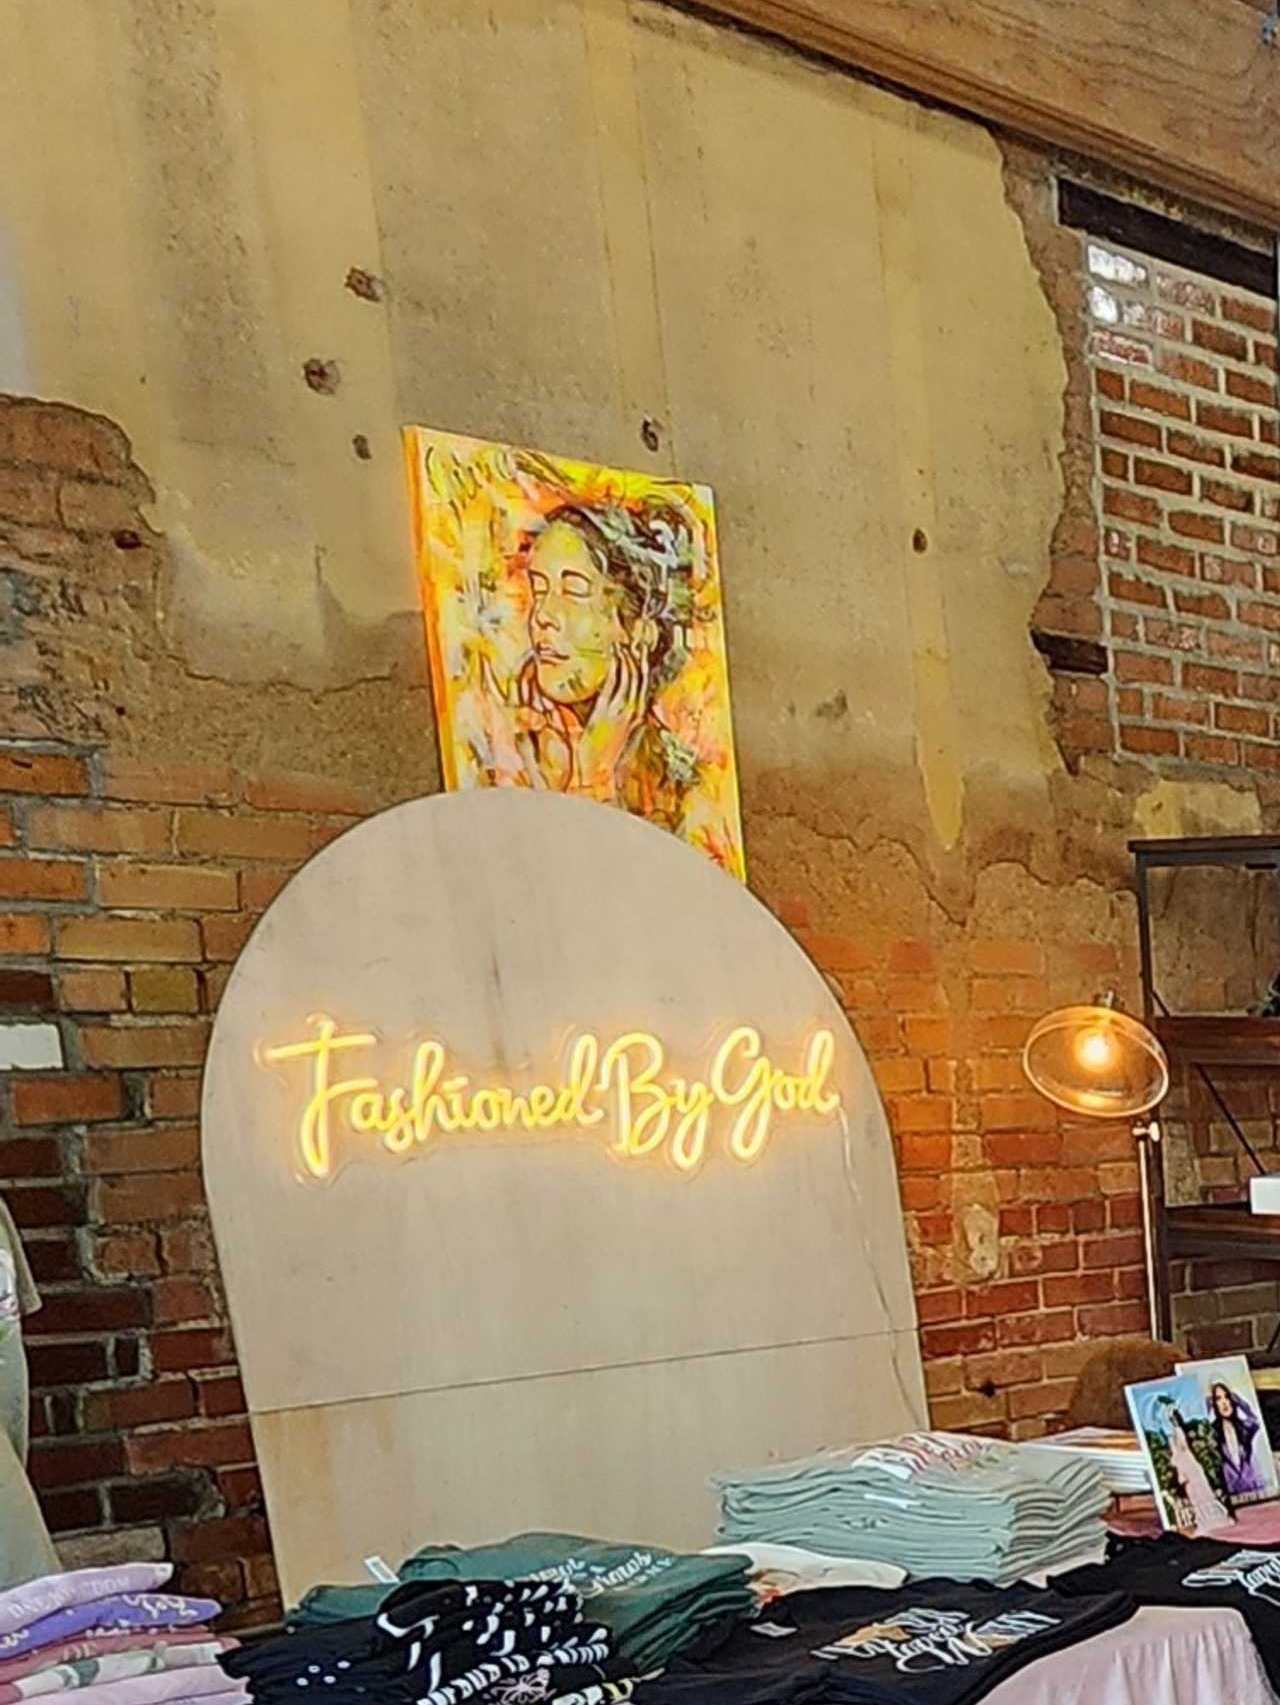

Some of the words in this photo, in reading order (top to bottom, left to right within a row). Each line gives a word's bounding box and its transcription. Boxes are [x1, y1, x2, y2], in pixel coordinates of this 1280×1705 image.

[265, 1013, 604, 1178] Fashioned
[602, 1031, 711, 1169] By
[710, 1026, 840, 1161] God
